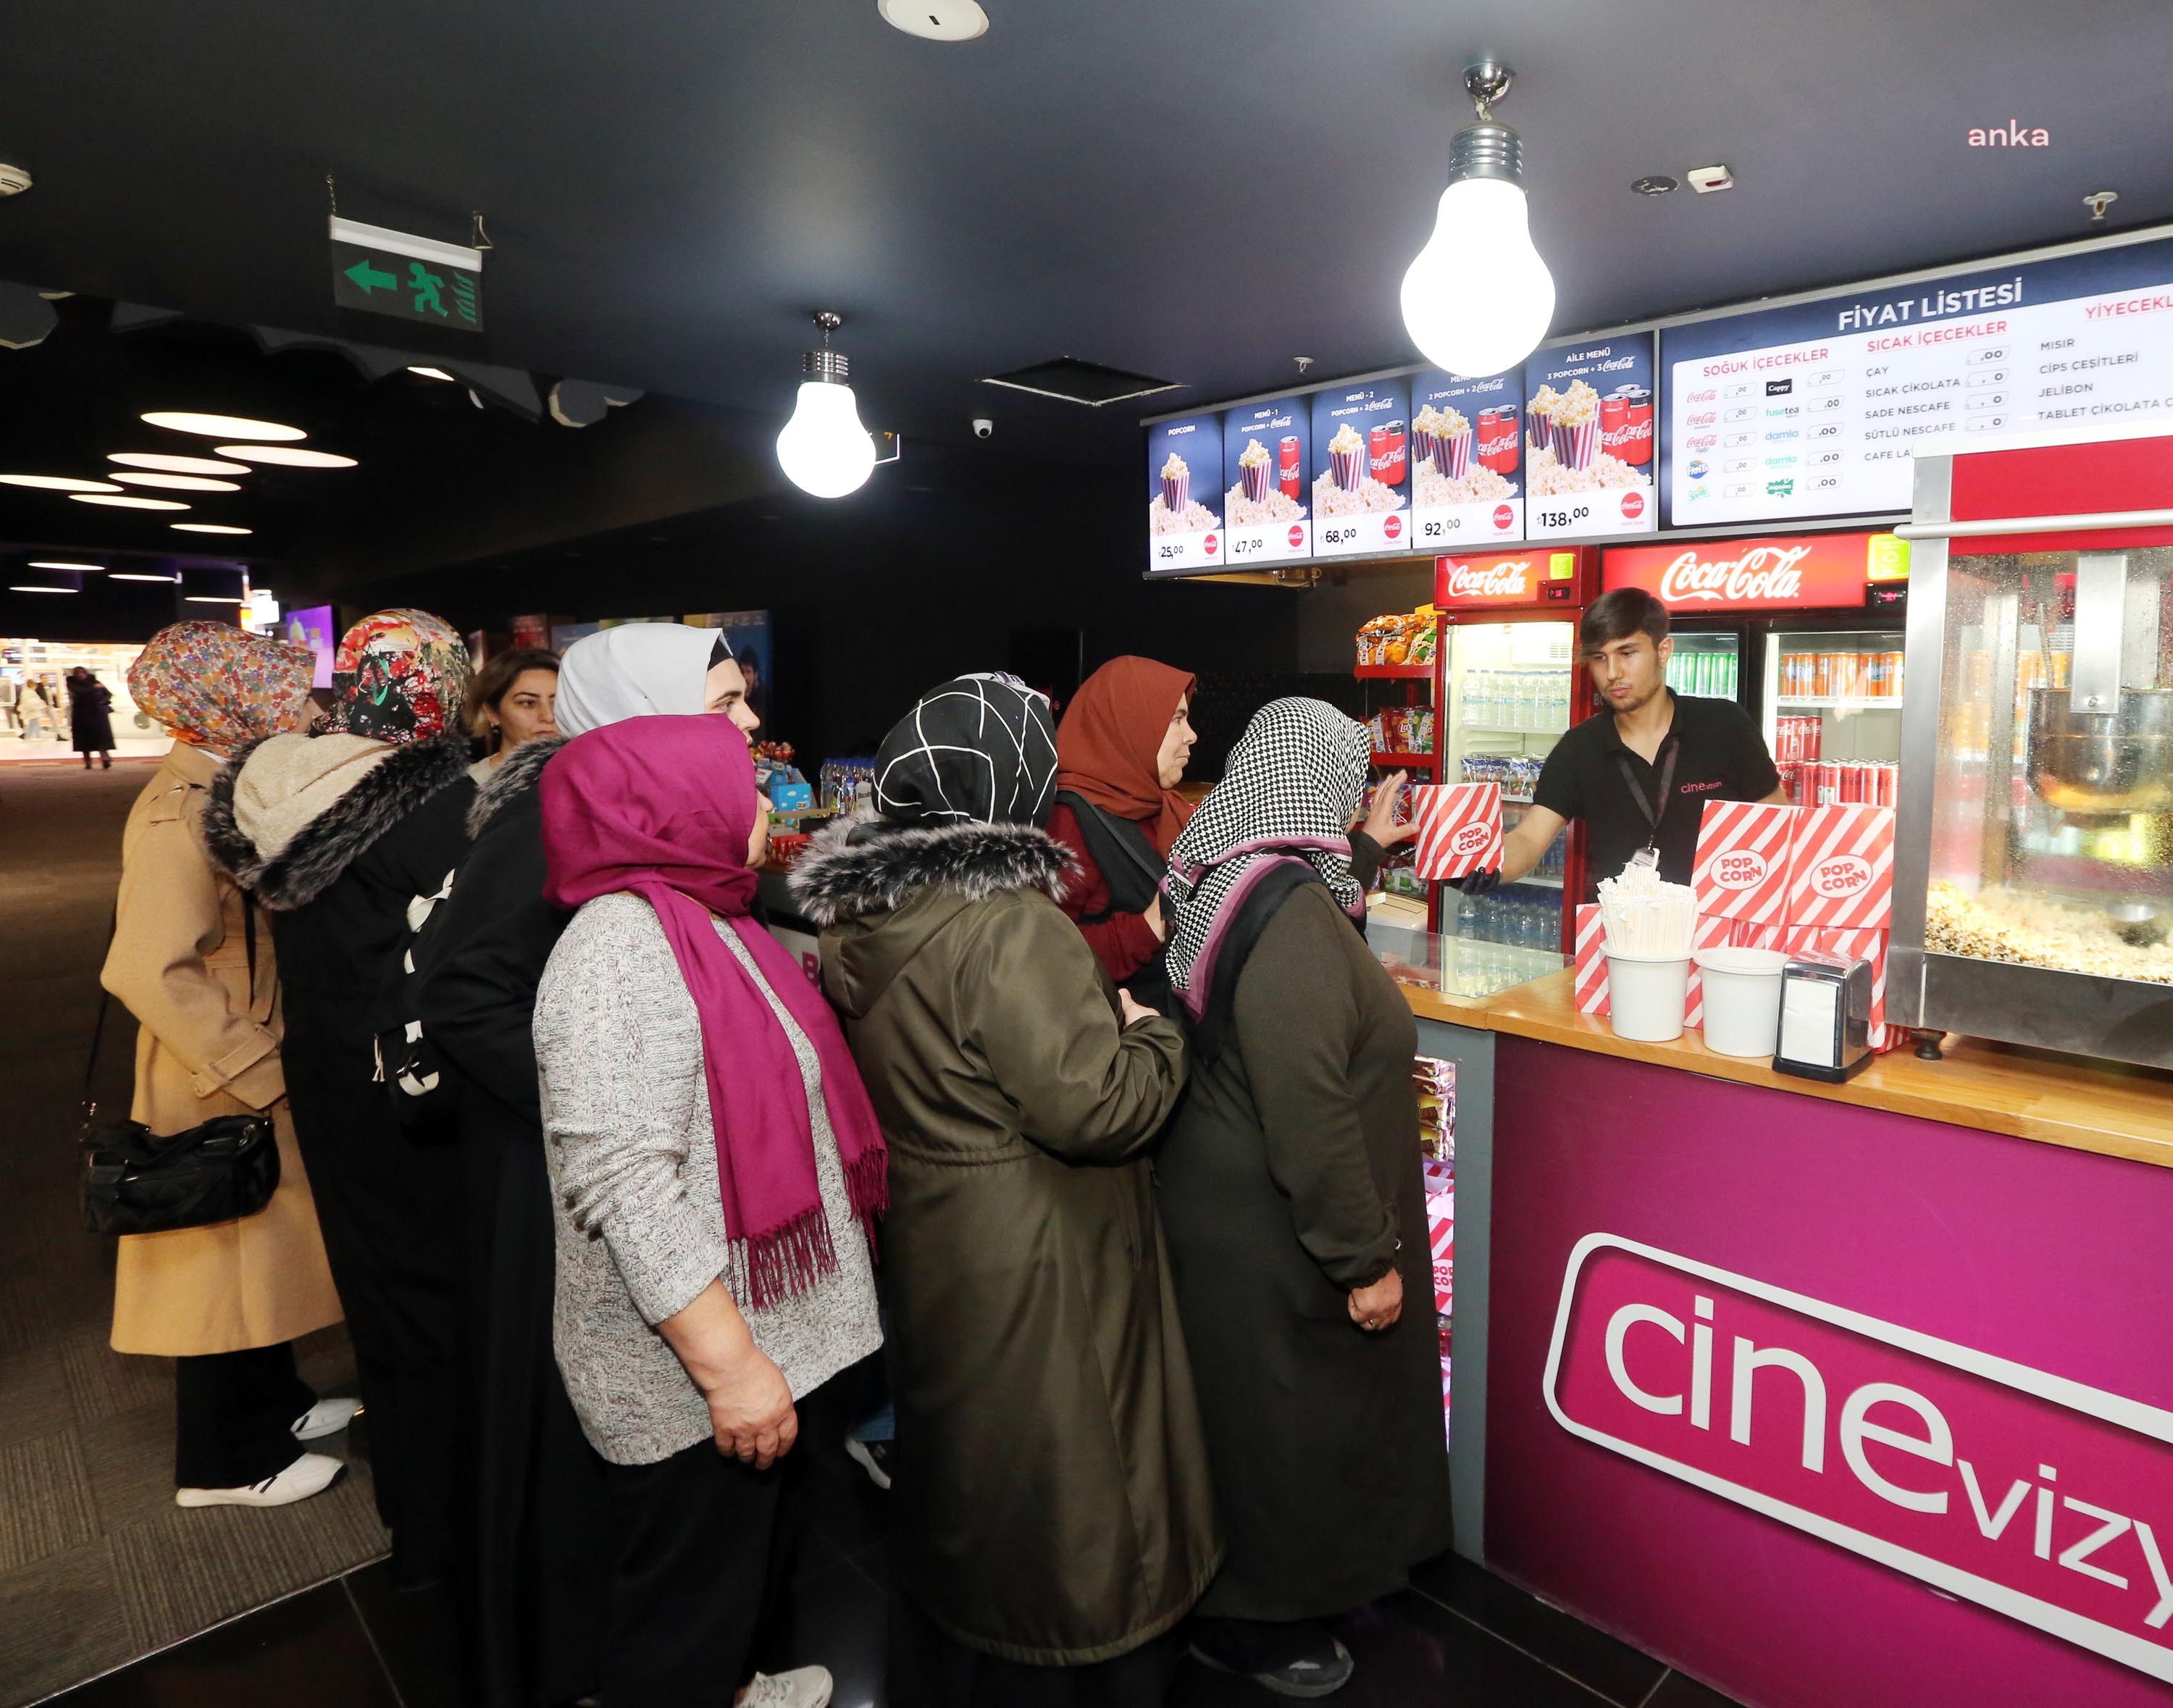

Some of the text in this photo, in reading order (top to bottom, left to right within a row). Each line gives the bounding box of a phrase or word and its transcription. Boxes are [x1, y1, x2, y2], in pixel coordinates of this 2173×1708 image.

[1838, 277, 2022, 331] FİYAT LİSTESİ
[1867, 321, 2008, 353] SICAK İÇECEKLER
[2040, 338, 2075, 351] MISIR
[1565, 347, 1611, 364] AİLE MENÜ
[1703, 348, 1829, 377] SOĞUK İÇECEKLER
[2039, 351, 2139, 374] CİPS ÇEŞİTLERİ
[1553, 367, 1589, 379] POPCORN
[1866, 367, 1889, 378] ÇAY
[1433, 388, 1465, 399] POPCORN
[1866, 386, 1898, 398] SICAK
[1902, 378, 1961, 393] ÇİKOLATA
[2038, 382, 2093, 398] JELİBON
[1346, 391, 1365, 402] MENÜ
[1255, 409, 1270, 419] MENÜ
[1331, 407, 1358, 417] POPCORN
[1766, 407, 1799, 417] fusetea
[1865, 408, 1894, 419] SADE
[1898, 401, 1951, 415] NESCAFE
[2038, 407, 2087, 420] TABLET
[2091, 399, 2161, 416] ÇİKOLATA
[1168, 424, 1195, 436] POPCORN
[1242, 423, 1265, 433] POPCORN
[1765, 430, 1799, 441] damla
[1865, 427, 1899, 440] SÜTLÜ
[1903, 423, 1956, 436] NESCAFE
[1765, 455, 1796, 465] damla
[1864, 449, 1913, 461] CAFE LA
[1660, 545, 1812, 602] Coca-Cola
[1459, 827, 1482, 841] POP
[1459, 832, 1489, 851] CORN
[1721, 857, 1753, 869] POP
[1820, 862, 1855, 879] POP
[1720, 866, 1762, 882] CORN
[1821, 869, 1867, 892] CORN
